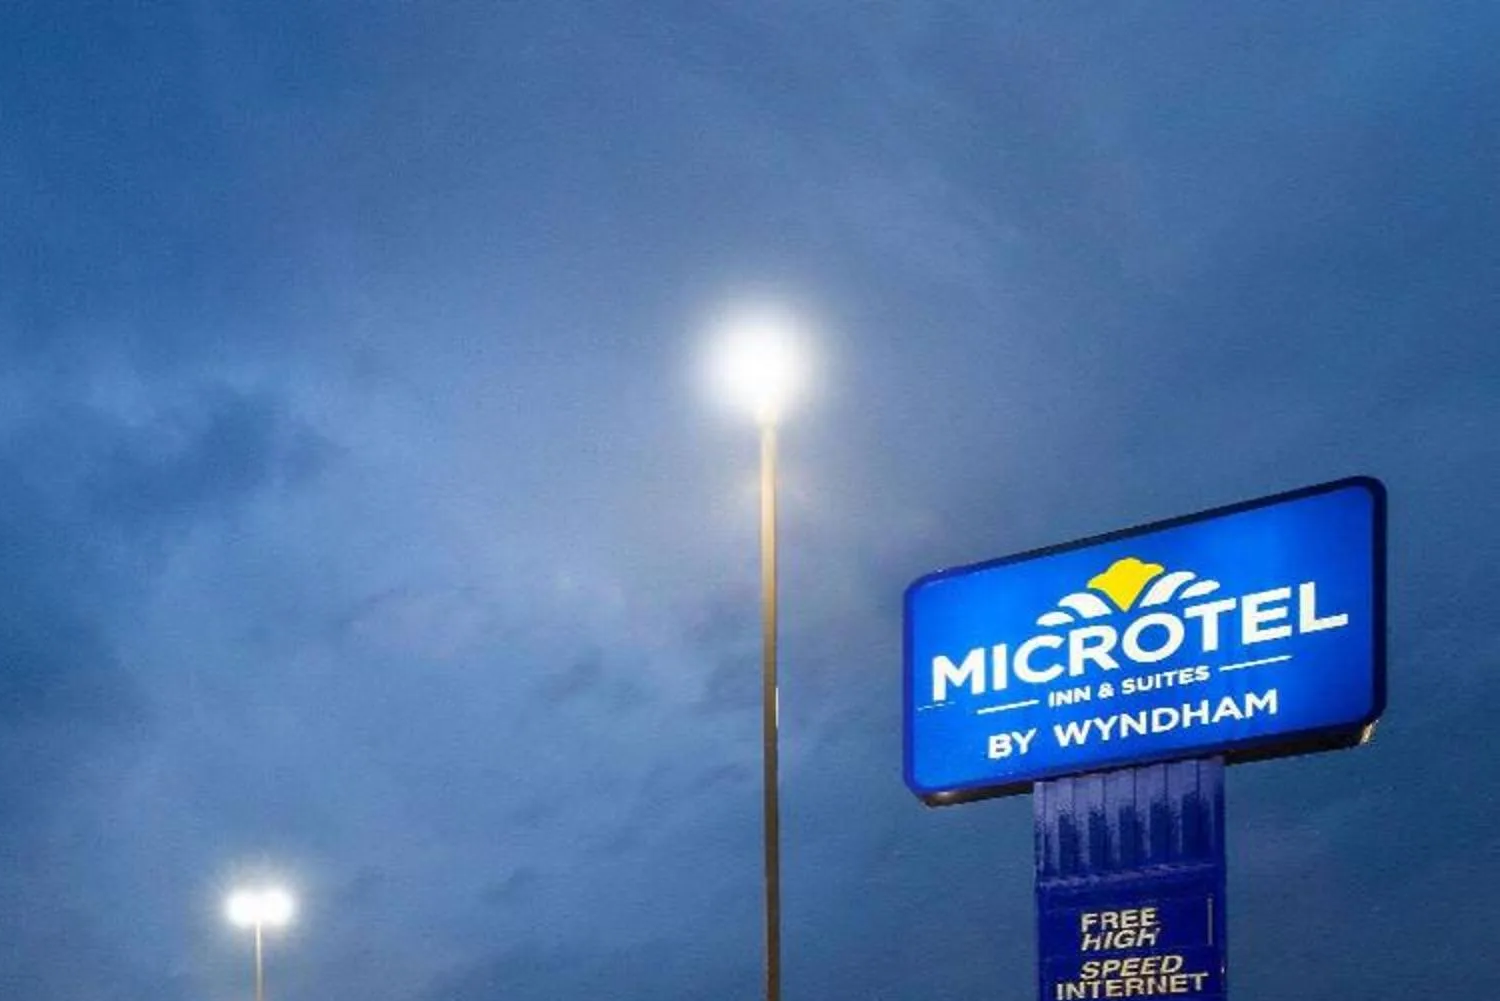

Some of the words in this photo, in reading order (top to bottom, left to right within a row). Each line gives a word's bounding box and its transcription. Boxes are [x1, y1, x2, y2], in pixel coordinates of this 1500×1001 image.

[932, 581, 1349, 701] MICROTEL
[1048, 687, 1091, 708] INN
[1098, 683, 1115, 699] &
[1122, 665, 1210, 695] SUITES
[987, 728, 1037, 760] BY
[1053, 689, 1278, 747] WYNDHAM
[1081, 907, 1158, 932] FREE
[1081, 928, 1159, 951] HIGH
[1080, 955, 1183, 980] SPEED
[1056, 972, 1208, 1000] INTERNET
